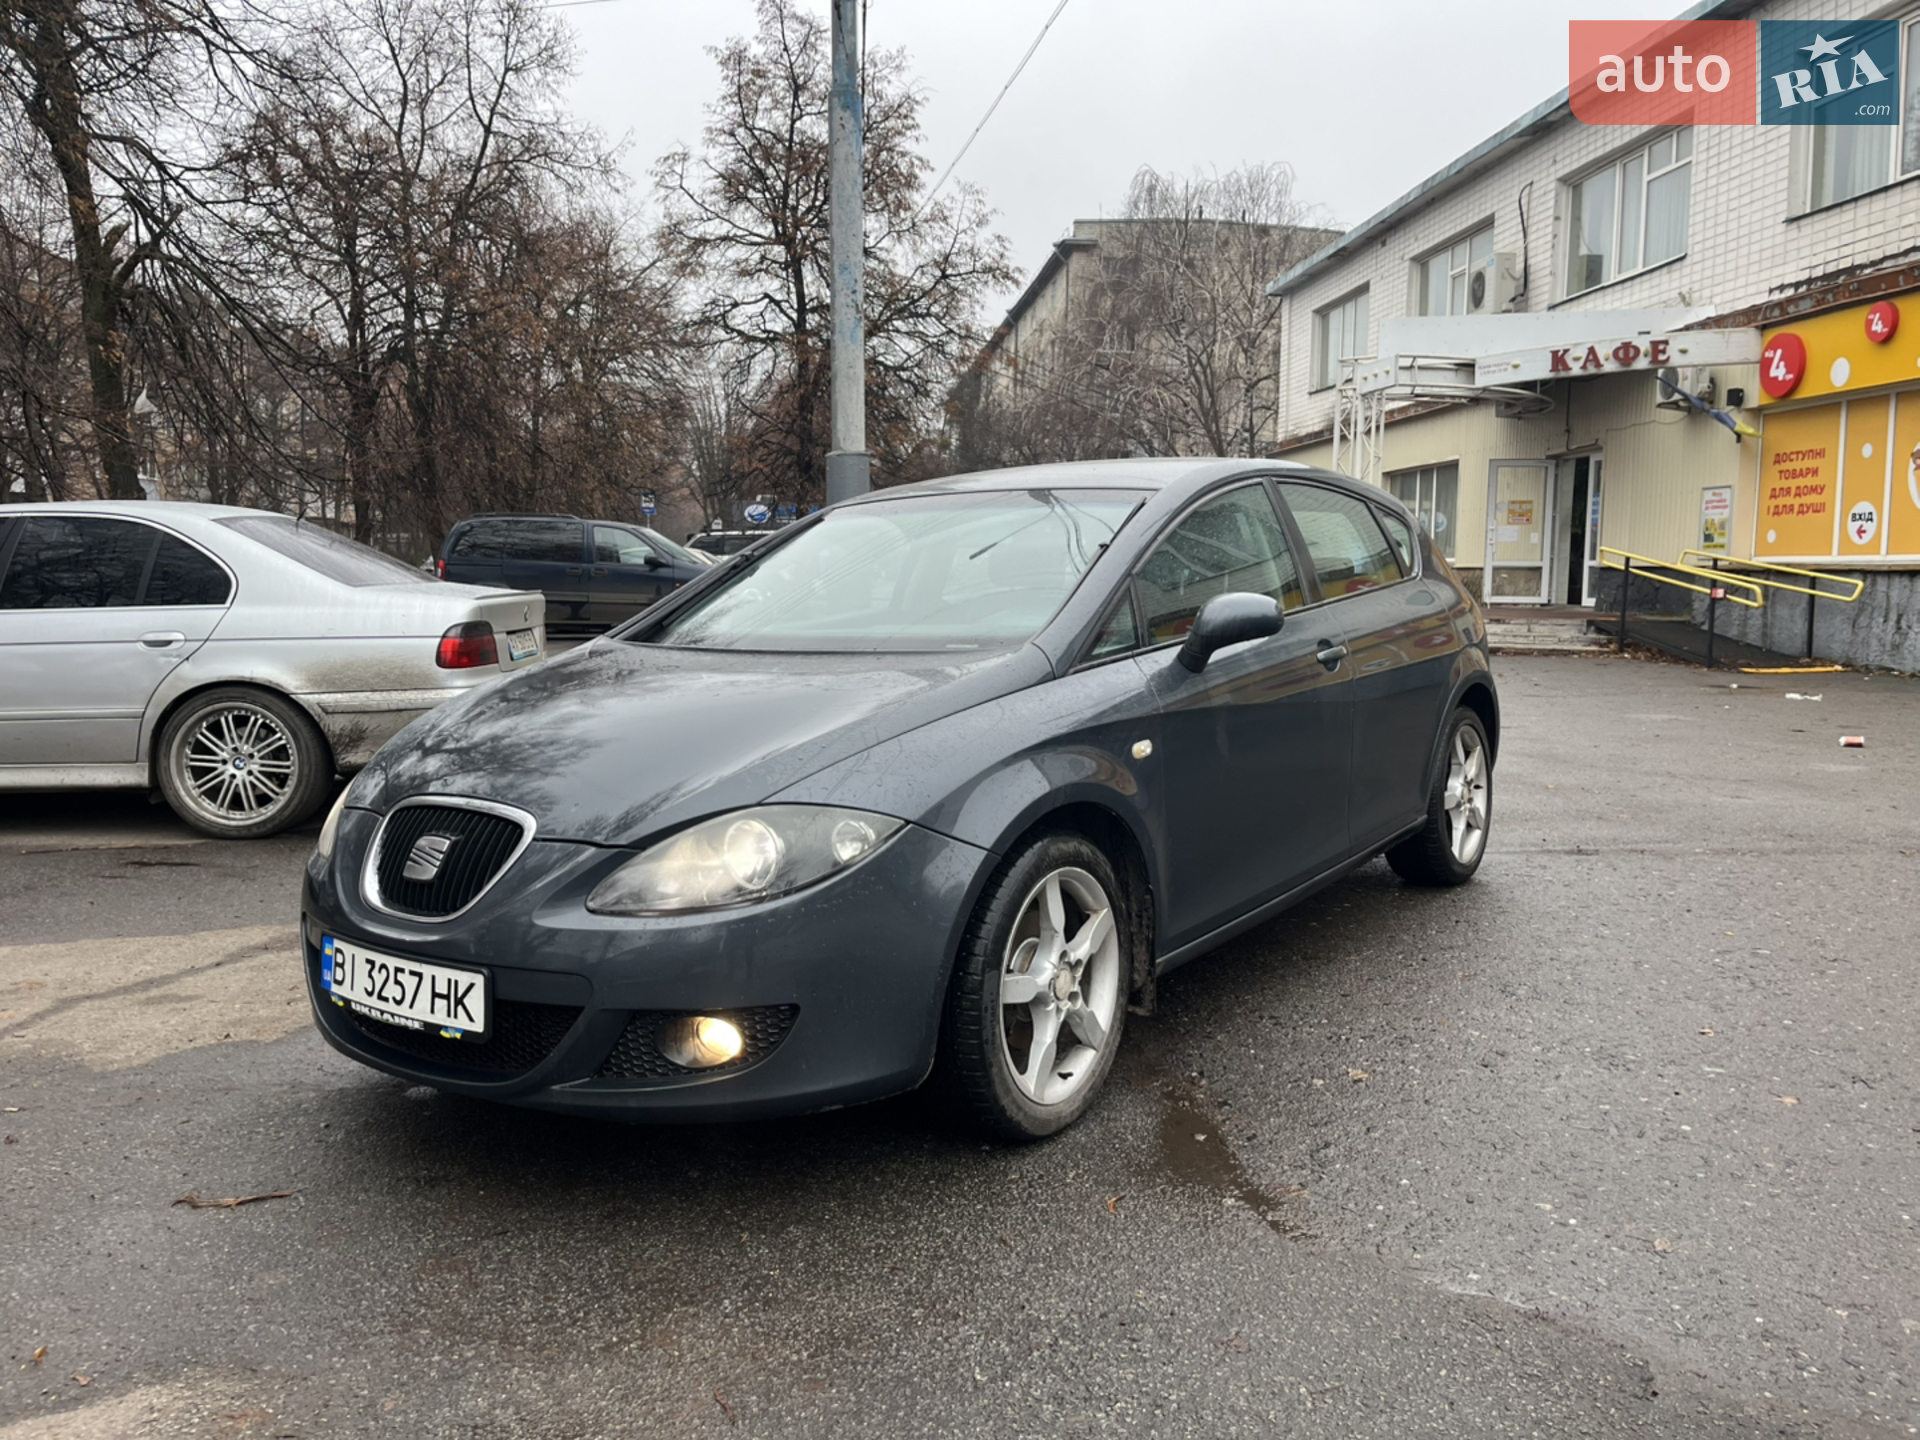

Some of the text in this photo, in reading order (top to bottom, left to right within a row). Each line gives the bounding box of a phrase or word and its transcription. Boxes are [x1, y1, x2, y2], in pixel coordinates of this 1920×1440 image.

[1549, 339, 1671, 373] КАФЕ
[1769, 348, 1786, 381] 4
[1773, 447, 1826, 466] ДОСТУПНІ
[1778, 466, 1819, 481] ТОВАРИ
[1769, 484, 1826, 500] ДЛЯ ДОМУ
[1766, 502, 1826, 517] І ДЛЯ ДУШІ
[1851, 512, 1874, 523] ВХІД
[333, 947, 476, 1023] BI 3257 HK
[351, 1001, 425, 1031] UKRAINE
